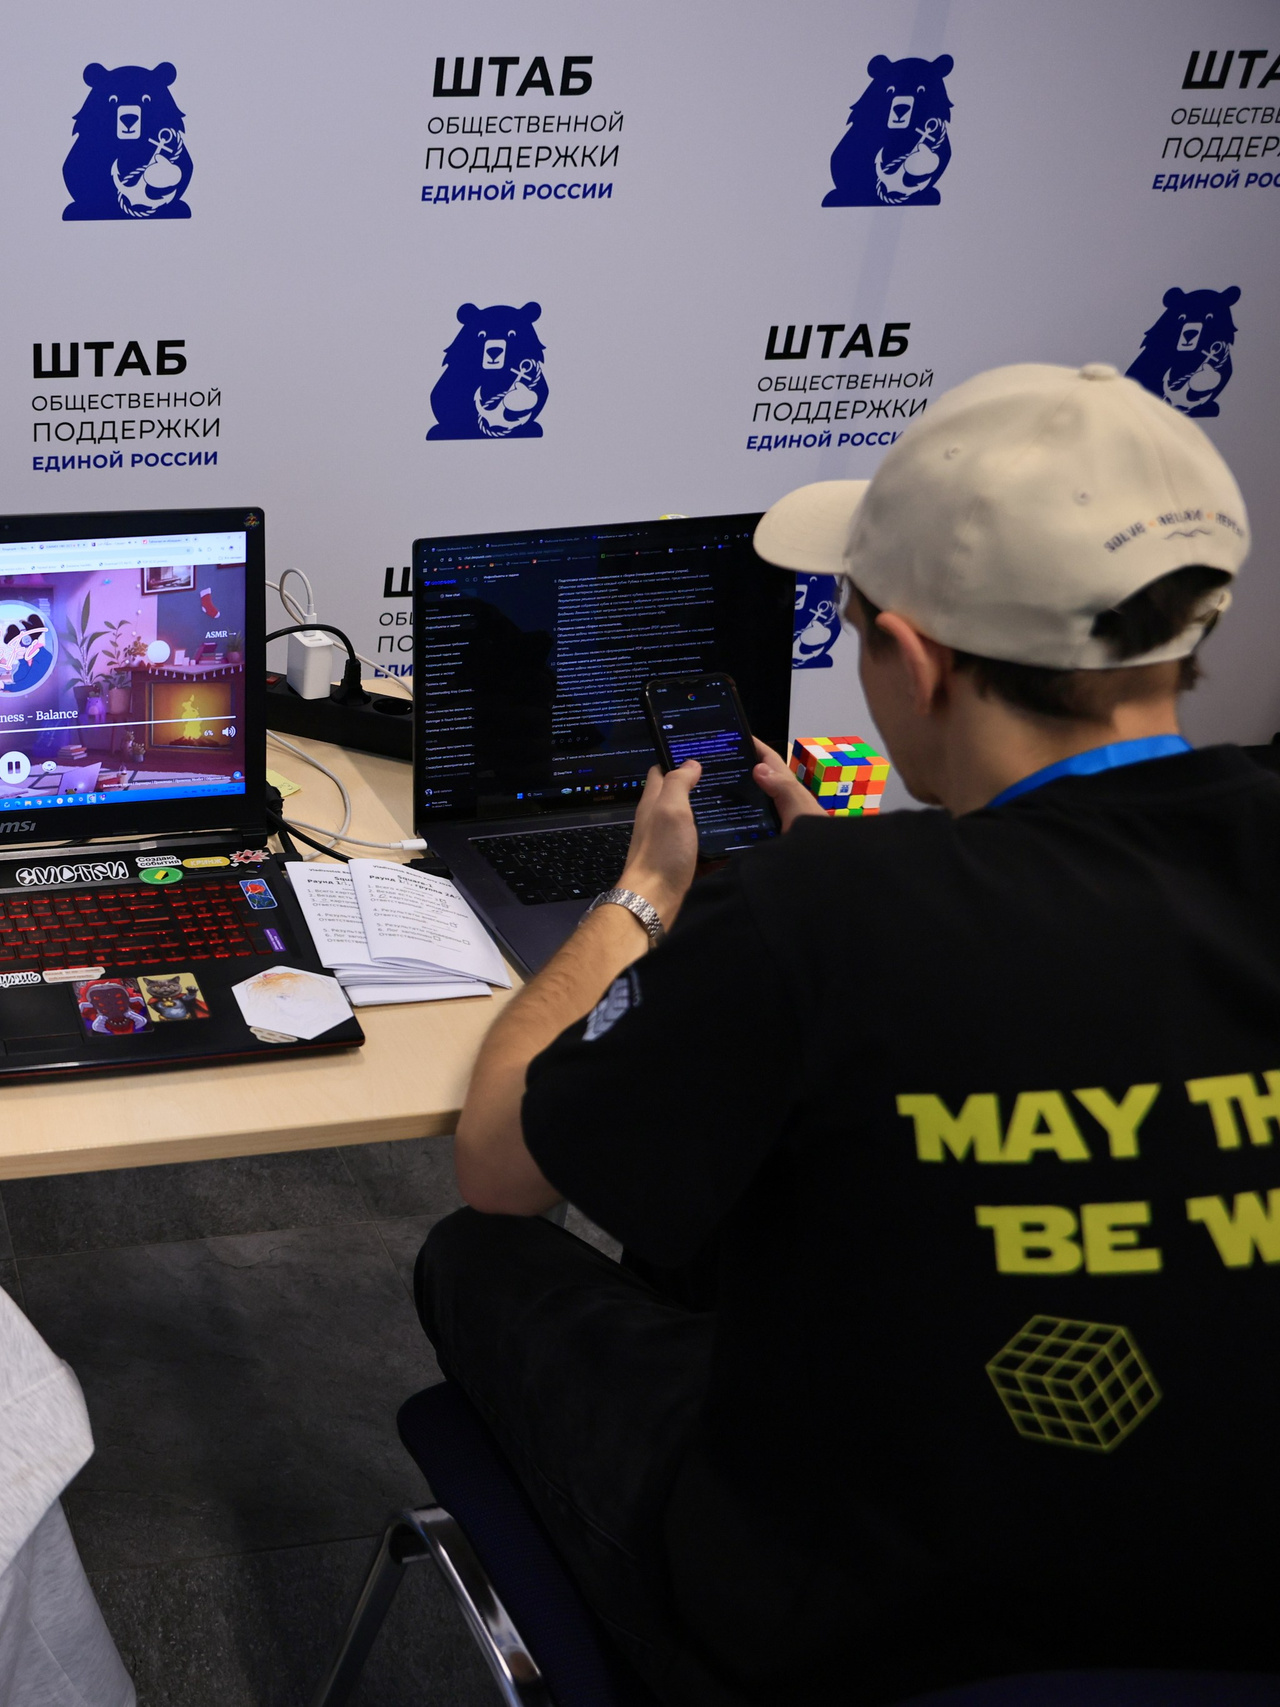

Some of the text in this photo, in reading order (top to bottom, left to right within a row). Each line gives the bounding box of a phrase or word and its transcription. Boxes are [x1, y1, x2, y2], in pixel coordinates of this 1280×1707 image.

[433, 56, 593, 97] ШТАБ
[428, 111, 623, 136] ОБЩЕСТВЕННОЙ
[426, 145, 619, 173] ПОДДЕРЖКИ
[1162, 136, 1280, 162] ПОДДЕР
[422, 181, 612, 204] ЕДИНОЙ РОССИИ
[1152, 169, 1240, 192] ЕДИНОЙ
[765, 323, 910, 360] ШТАБ
[33, 340, 187, 378] ШТАБ
[758, 369, 933, 393] ОБЩЕСТВЕННОЙ
[32, 388, 220, 413] ОБЩЕСТВЕННОЙ
[753, 399, 927, 424] ПОДДЕРЖКИ
[34, 418, 219, 445] ПОДДЕРЖКИ
[747, 430, 832, 451] ЕДИНОЙ
[33, 451, 217, 472] ЕДИНОЙ РОССИИ
[1104, 522, 1146, 552] SOLVE
[205, 630, 228, 639] ASMR
[36, 709, 78, 721] Balance
[204, 729, 214, 737] 6%
[190, 859, 223, 867] КРИНЖ
[369, 875, 396, 883] Раунд
[896, 1084, 1161, 1163] MAY
[975, 1201, 1162, 1274] BE
